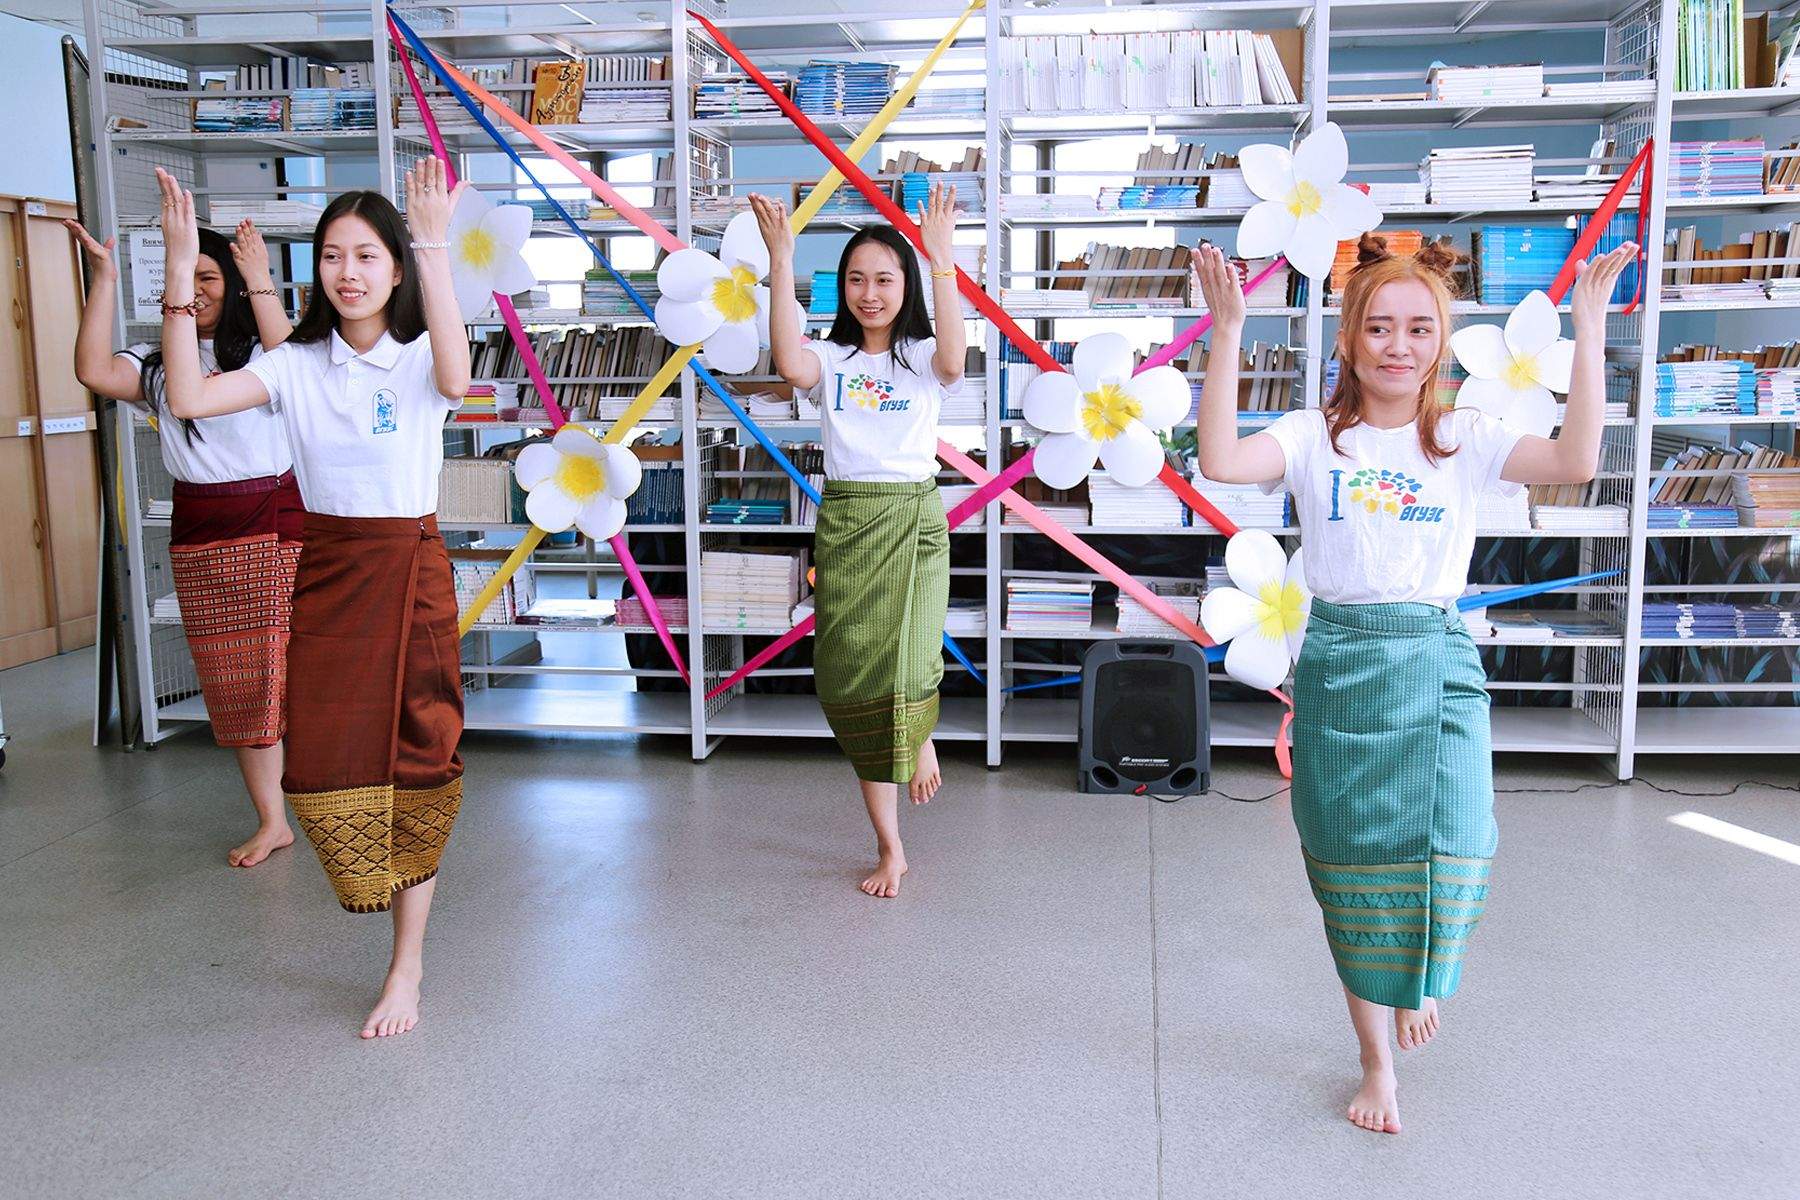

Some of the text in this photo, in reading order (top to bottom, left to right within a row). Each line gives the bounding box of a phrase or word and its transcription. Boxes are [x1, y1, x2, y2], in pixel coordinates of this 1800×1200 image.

[834, 373, 910, 411] I ВГУЭС
[1328, 470, 1446, 522] I ВГУЭС
